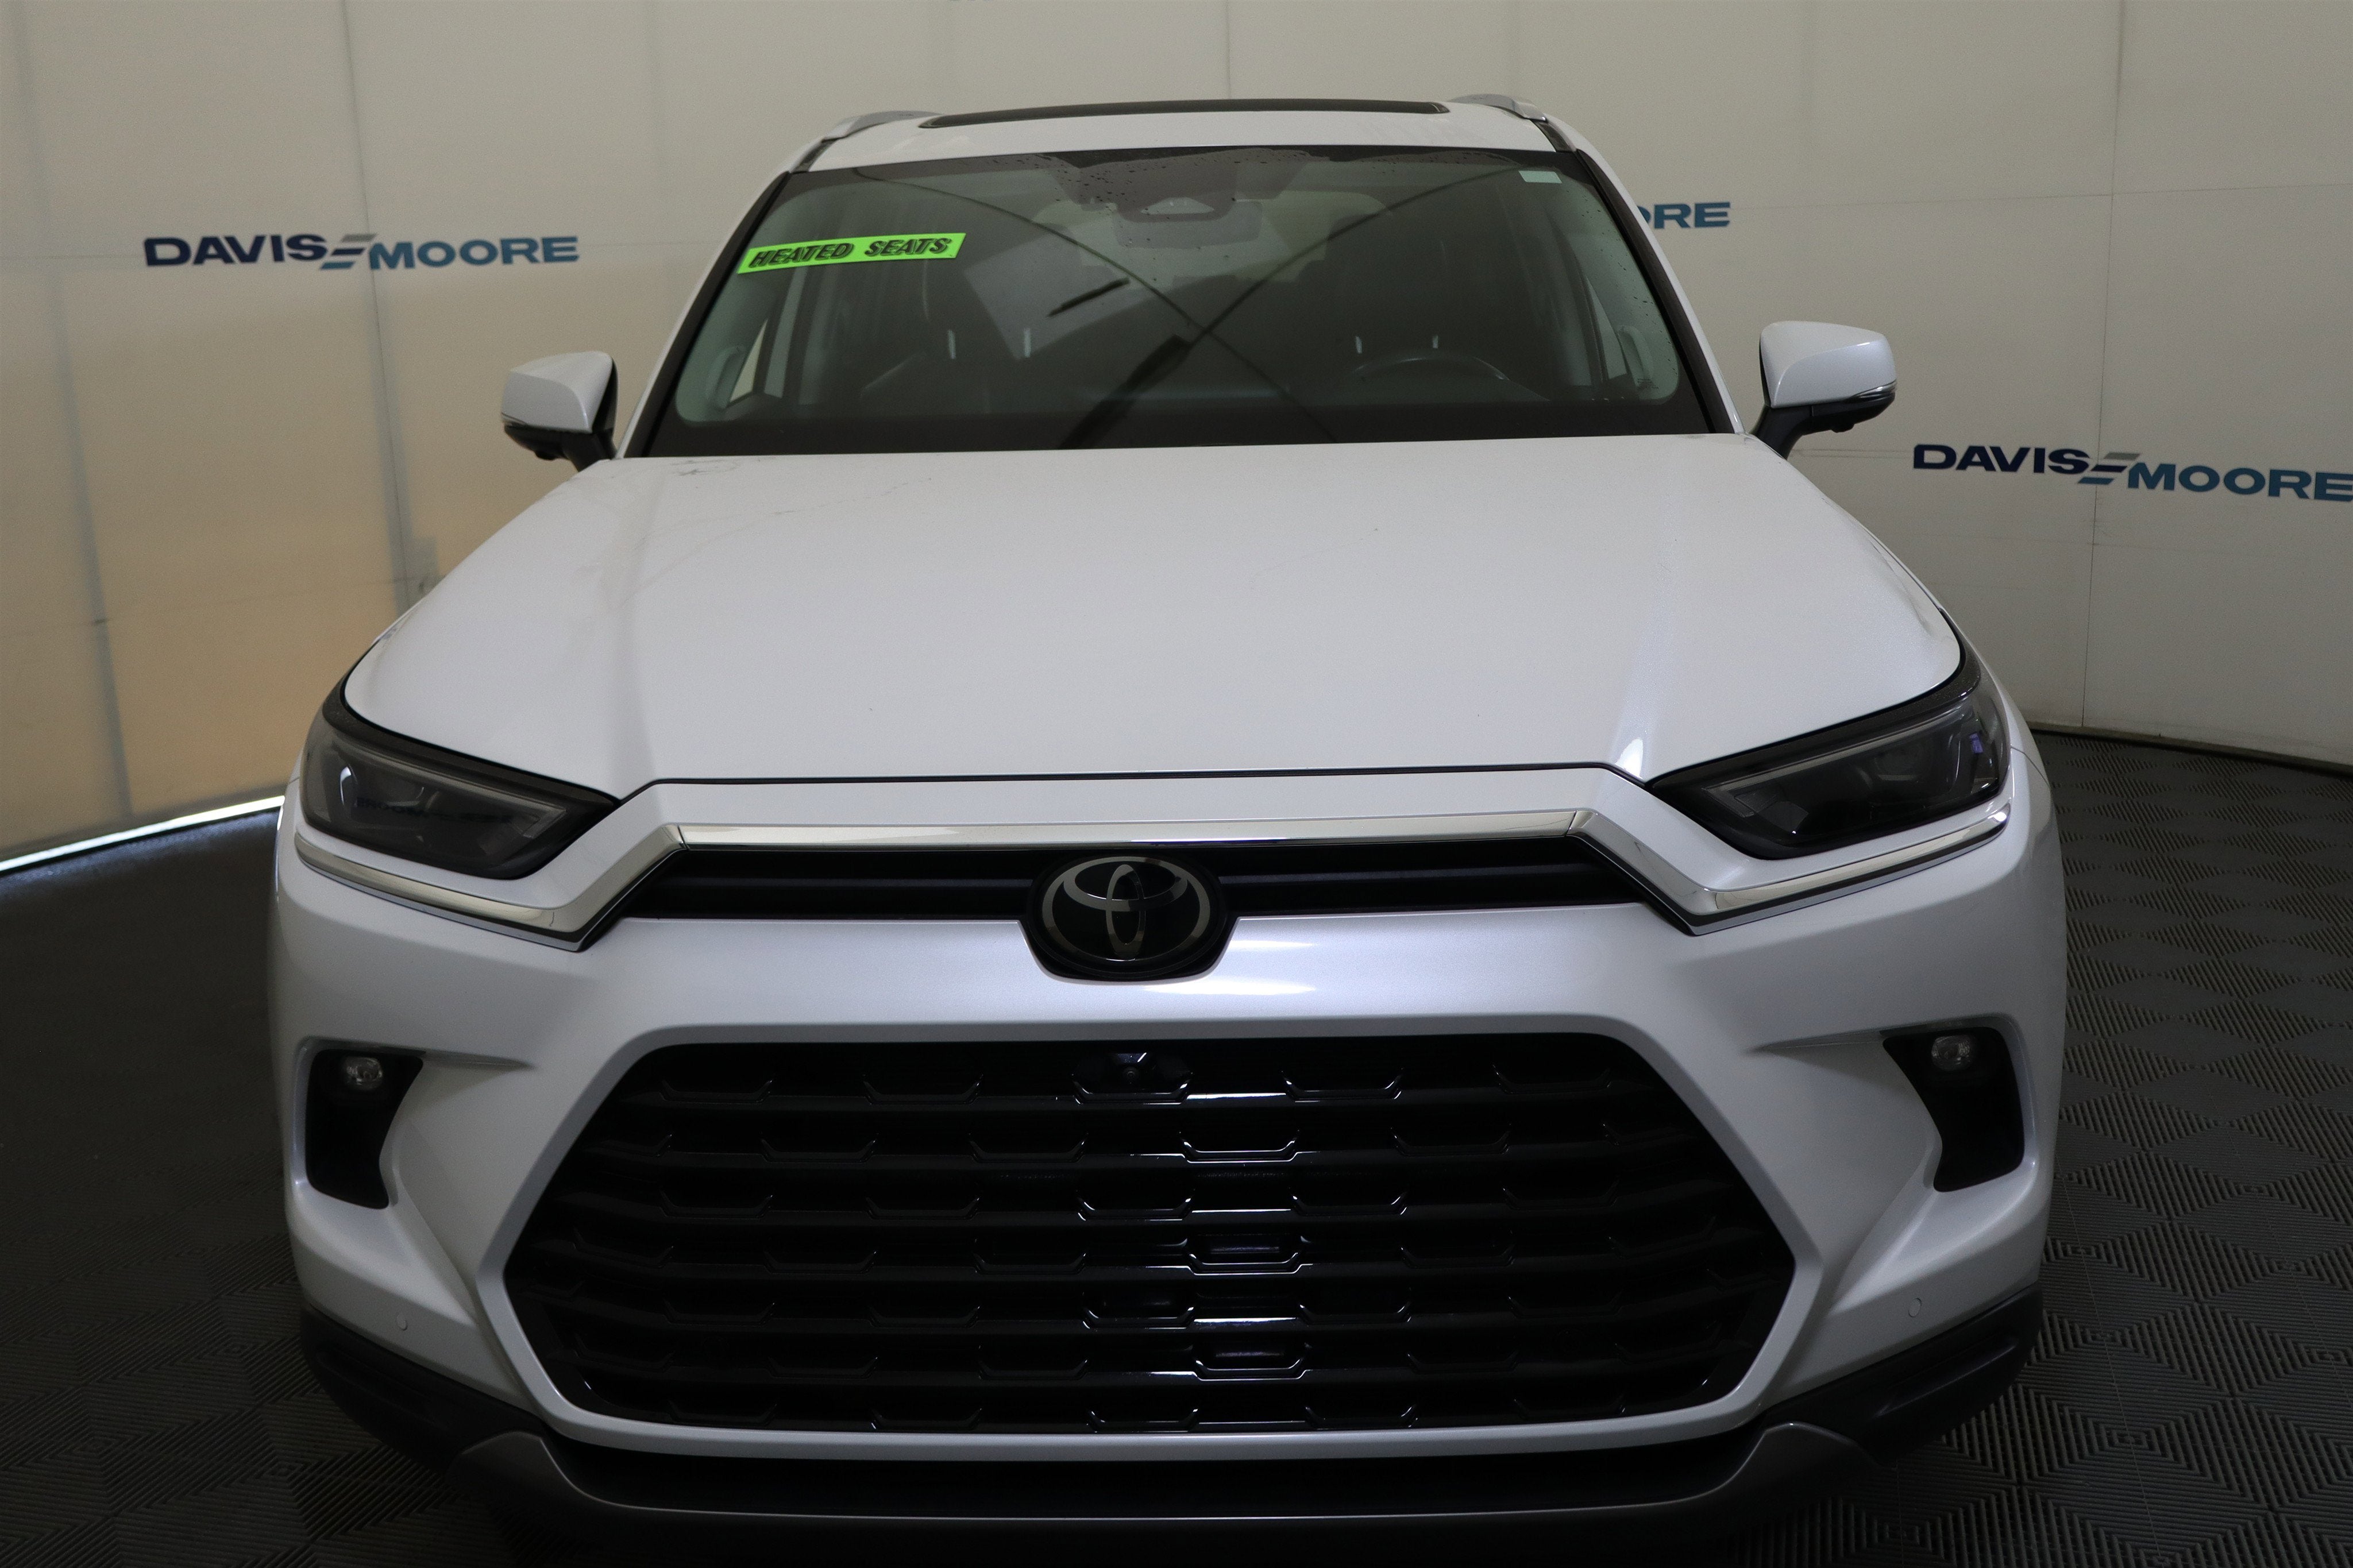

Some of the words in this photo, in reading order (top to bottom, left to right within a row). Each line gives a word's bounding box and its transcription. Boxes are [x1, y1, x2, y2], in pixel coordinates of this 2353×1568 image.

[143, 234, 327, 266] DAVIS
[369, 236, 580, 270] MOORE
[748, 242, 854, 268] HEATED
[864, 238, 952, 257] SEATS
[1913, 444, 2090, 474] DAVIS
[2127, 462, 2353, 501] MOORE
